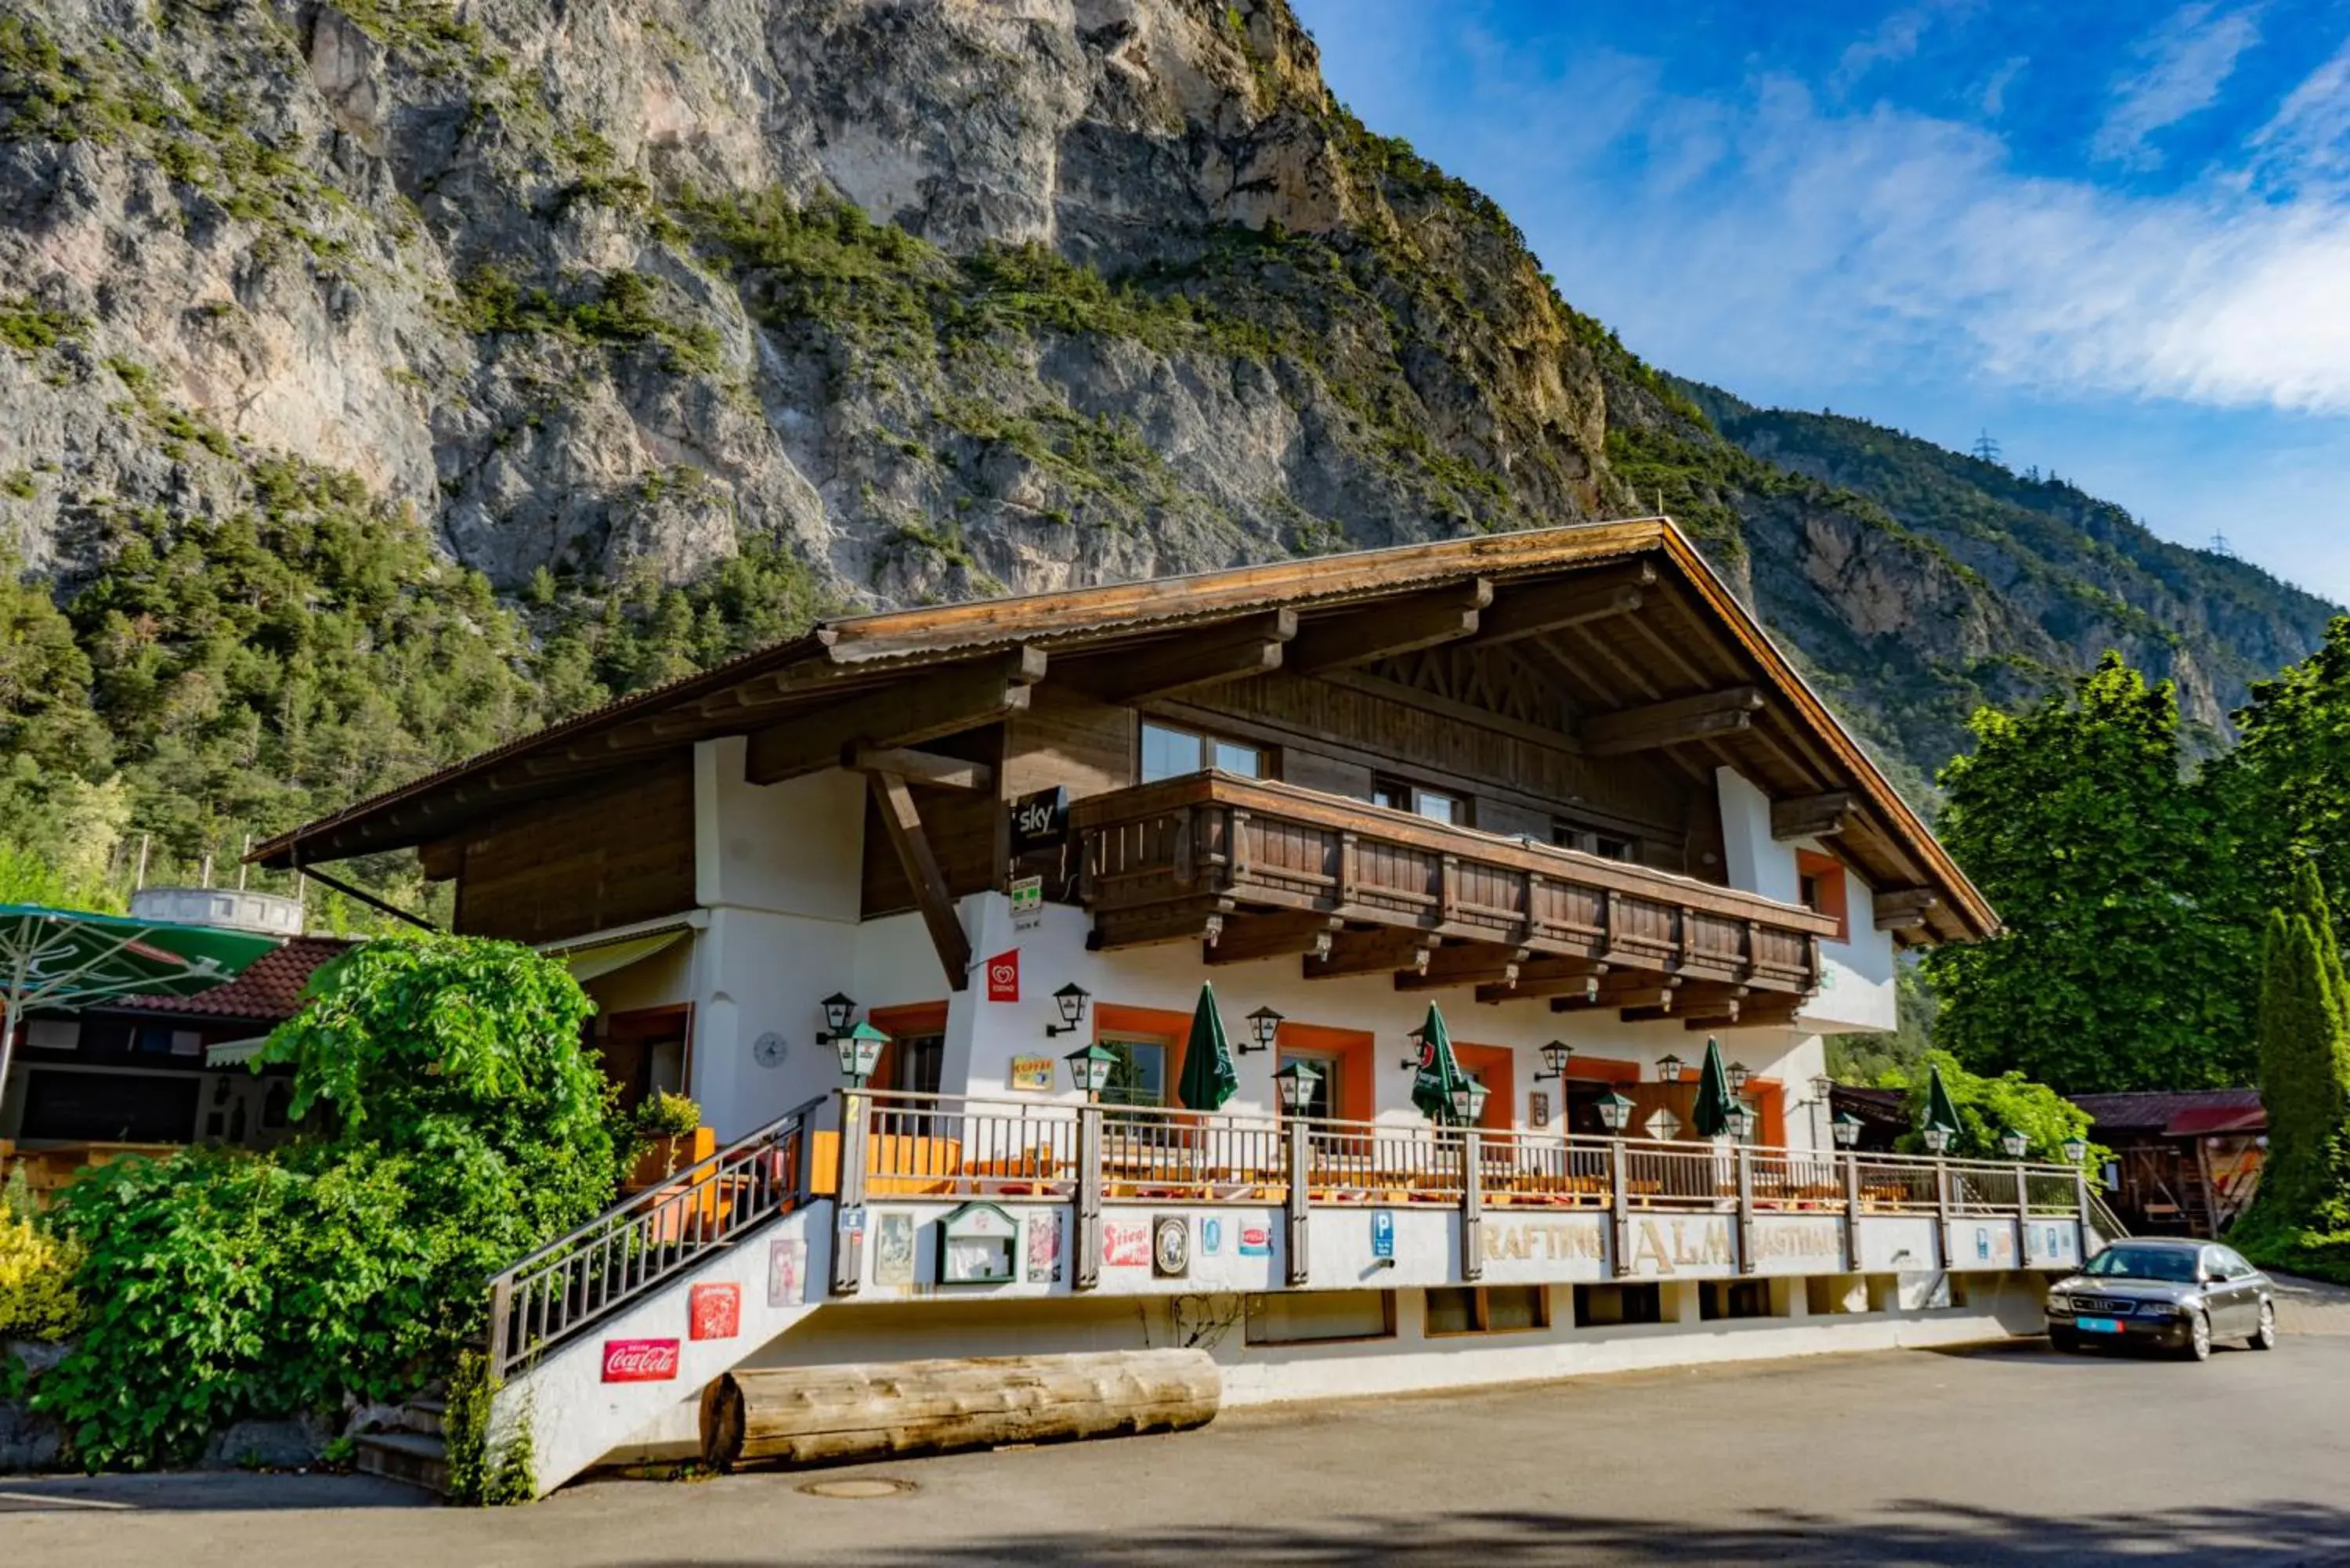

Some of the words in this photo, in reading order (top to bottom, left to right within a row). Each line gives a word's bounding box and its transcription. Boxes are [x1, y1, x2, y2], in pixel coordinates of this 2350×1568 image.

[1019, 803, 1054, 833] sky
[1379, 1215, 1389, 1237] P
[1482, 1223, 1605, 1262] RAFTING
[1629, 1219, 1736, 1275] ALM
[606, 1346, 678, 1375] Coca-Cola
